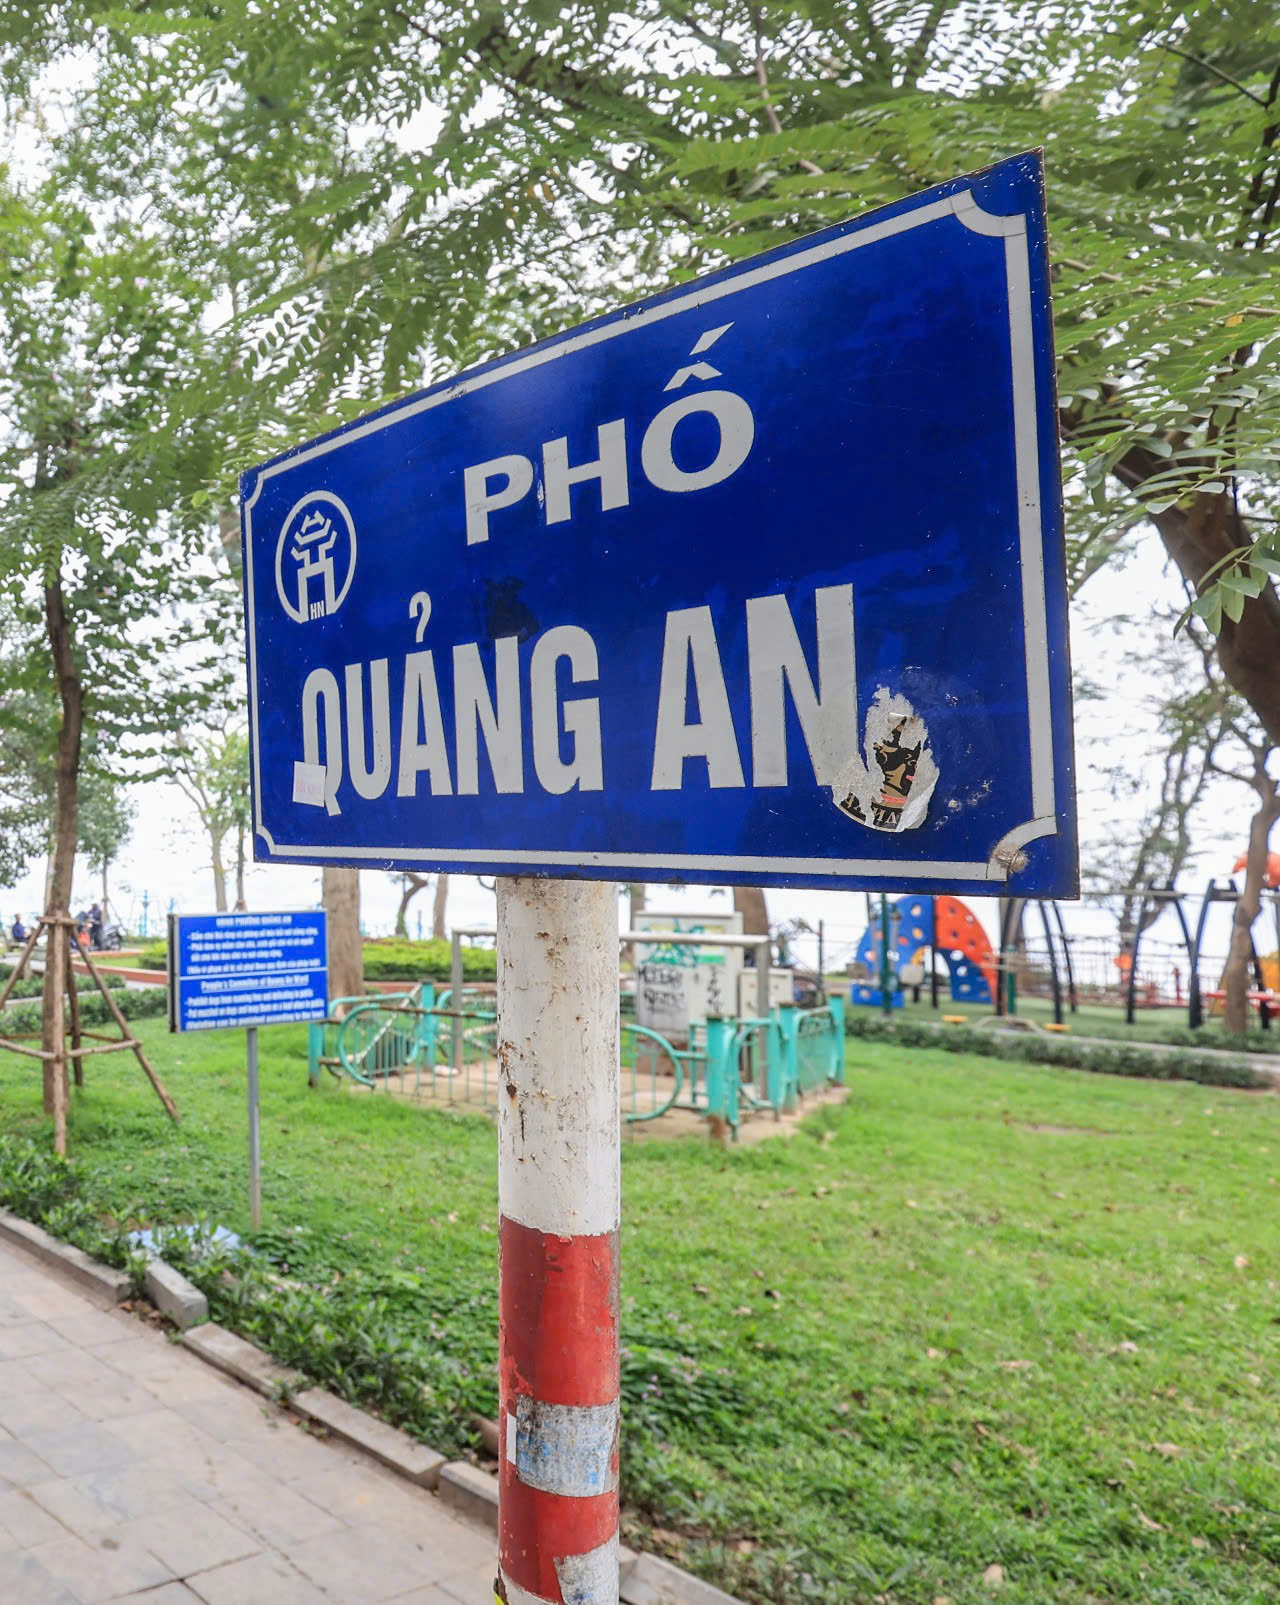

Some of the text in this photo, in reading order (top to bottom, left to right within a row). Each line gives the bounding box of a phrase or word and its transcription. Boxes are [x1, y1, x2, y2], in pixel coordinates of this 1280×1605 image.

[464, 321, 755, 546] PHỐ
[302, 583, 859, 817] QUẢNG AN
[310, 600, 325, 620] HN
